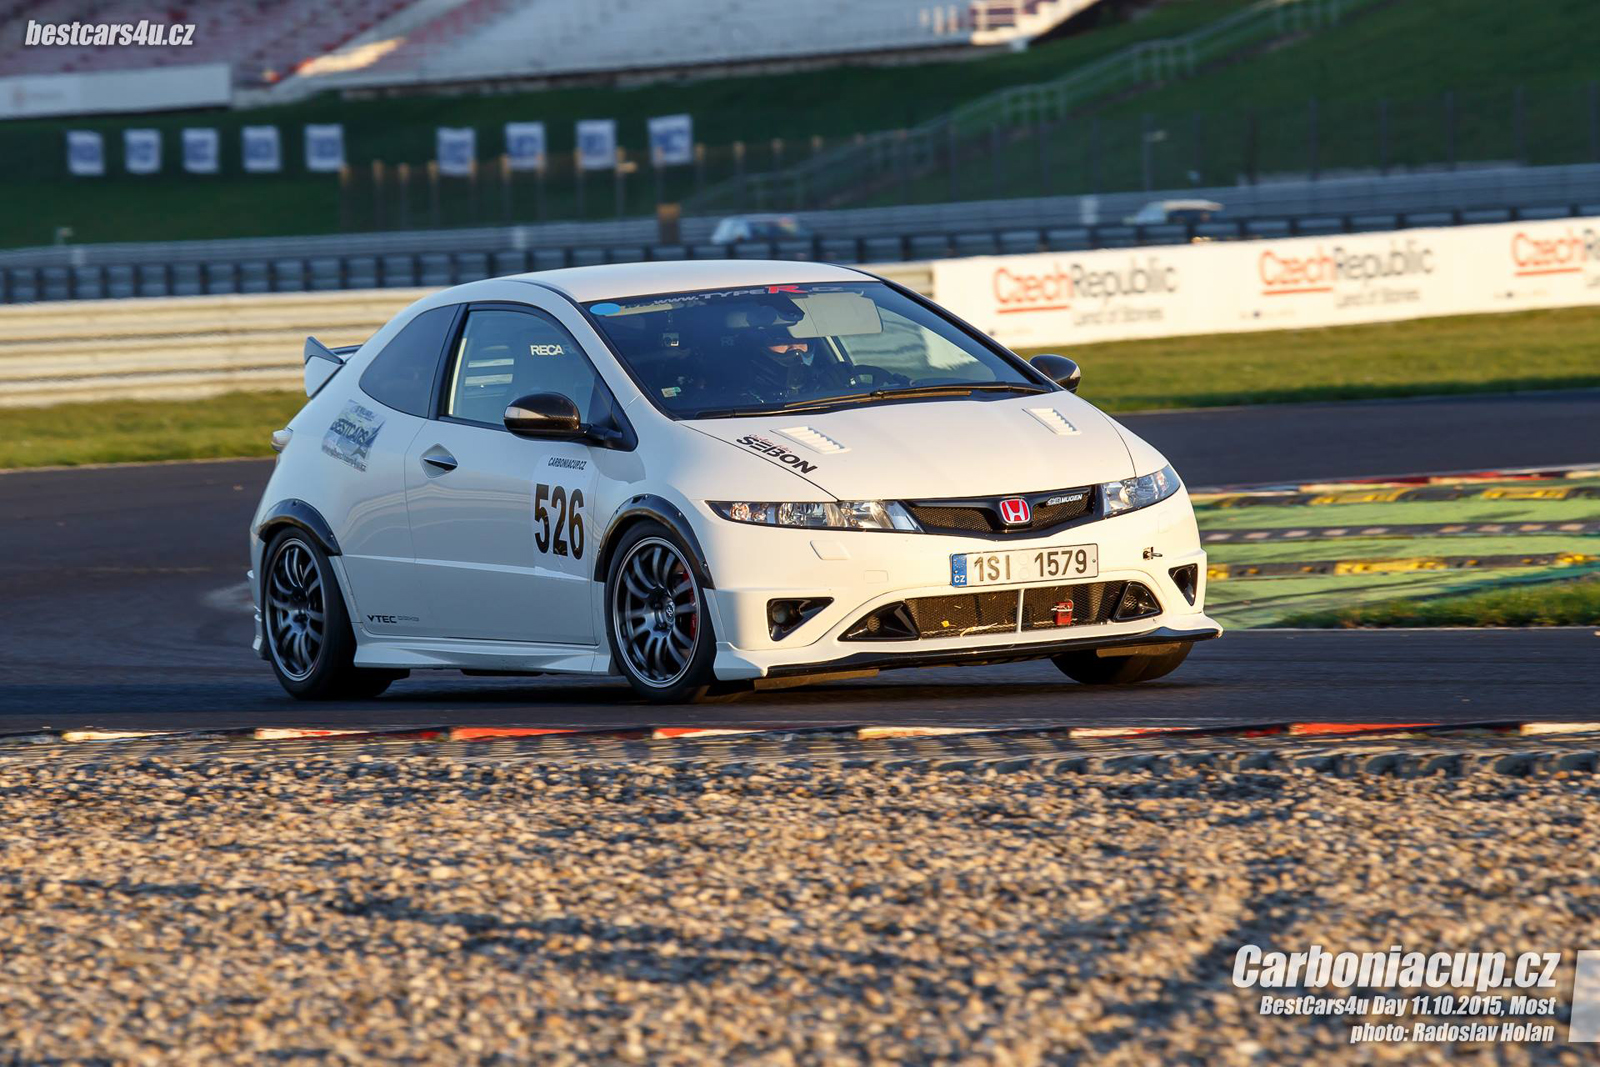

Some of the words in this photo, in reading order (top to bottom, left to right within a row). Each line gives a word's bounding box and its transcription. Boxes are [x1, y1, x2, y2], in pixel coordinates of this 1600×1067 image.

[736, 436, 818, 474] SEBON
[535, 483, 584, 560] 526
[954, 574, 966, 583] CZ
[974, 554, 1011, 582] 1SI
[1034, 549, 1087, 578] 1579
